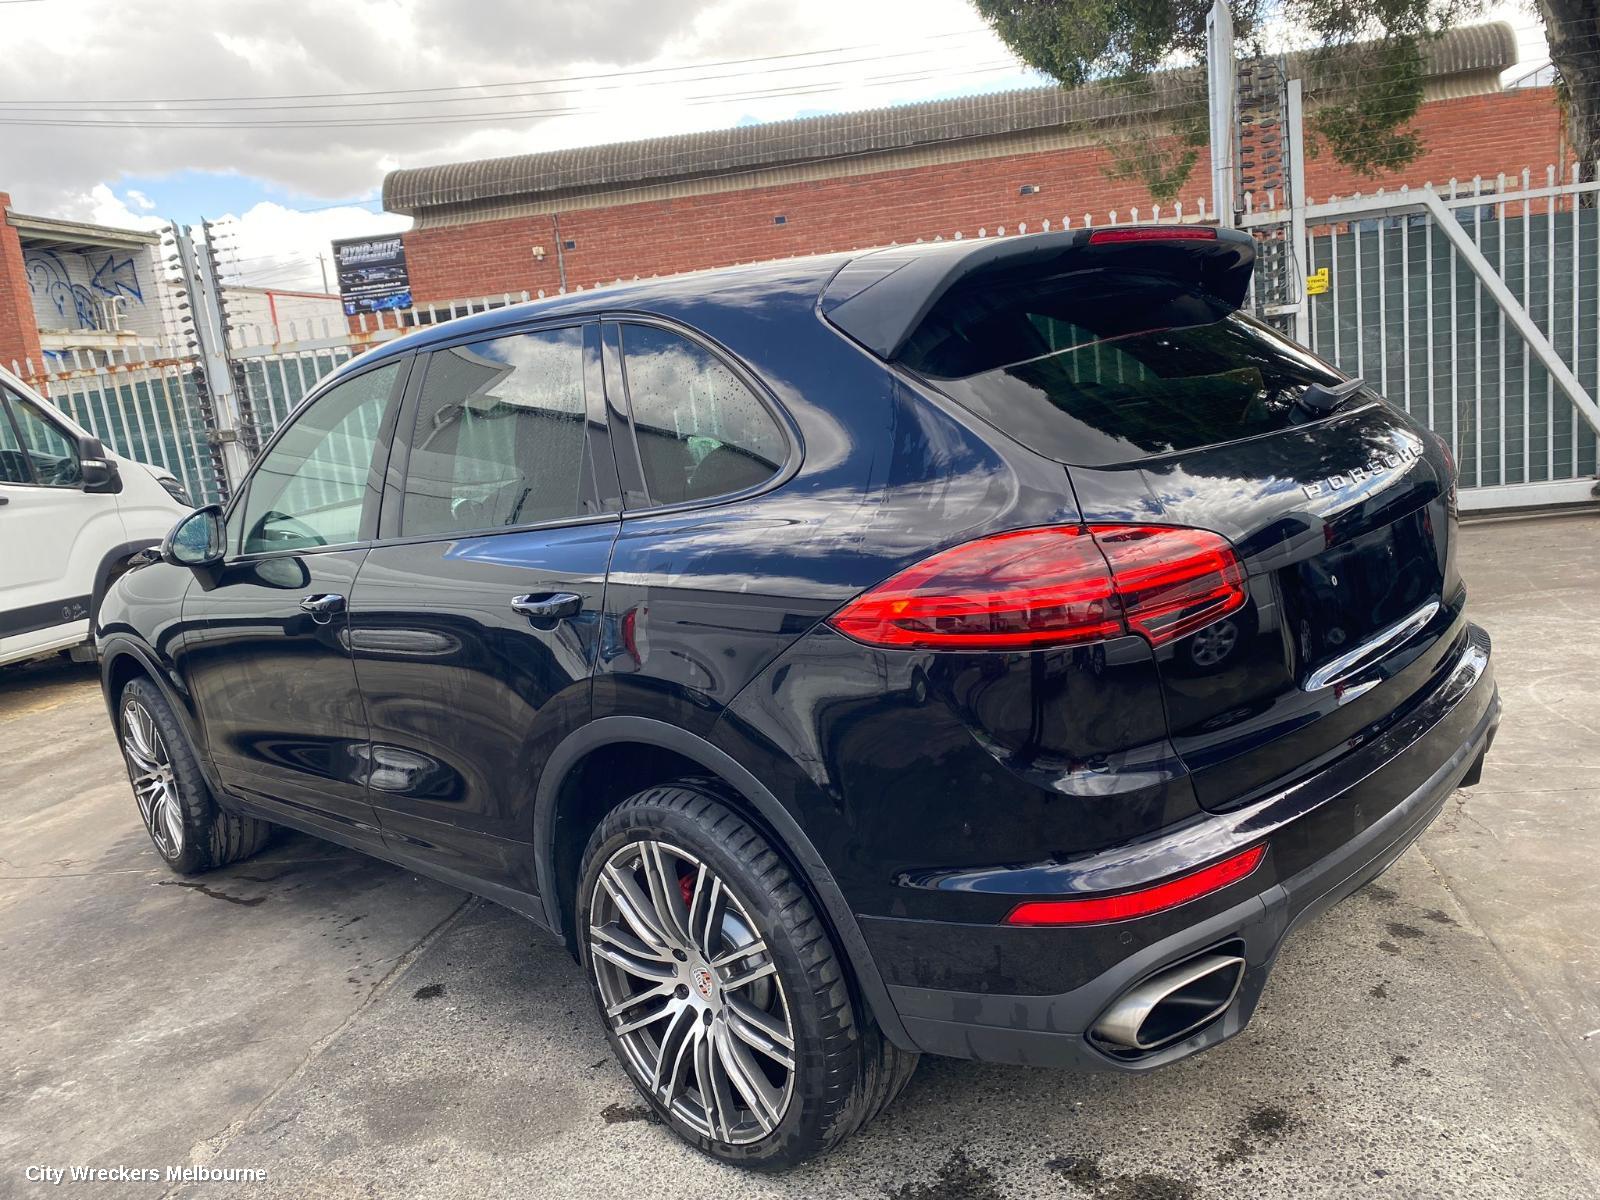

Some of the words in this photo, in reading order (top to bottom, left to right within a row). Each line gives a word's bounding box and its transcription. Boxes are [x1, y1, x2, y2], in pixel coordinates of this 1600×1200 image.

[341, 240, 400, 258] DYNO-MITE
[342, 251, 397, 265] PERFORMANCE
[1302, 445, 1424, 500] PORSCHE
